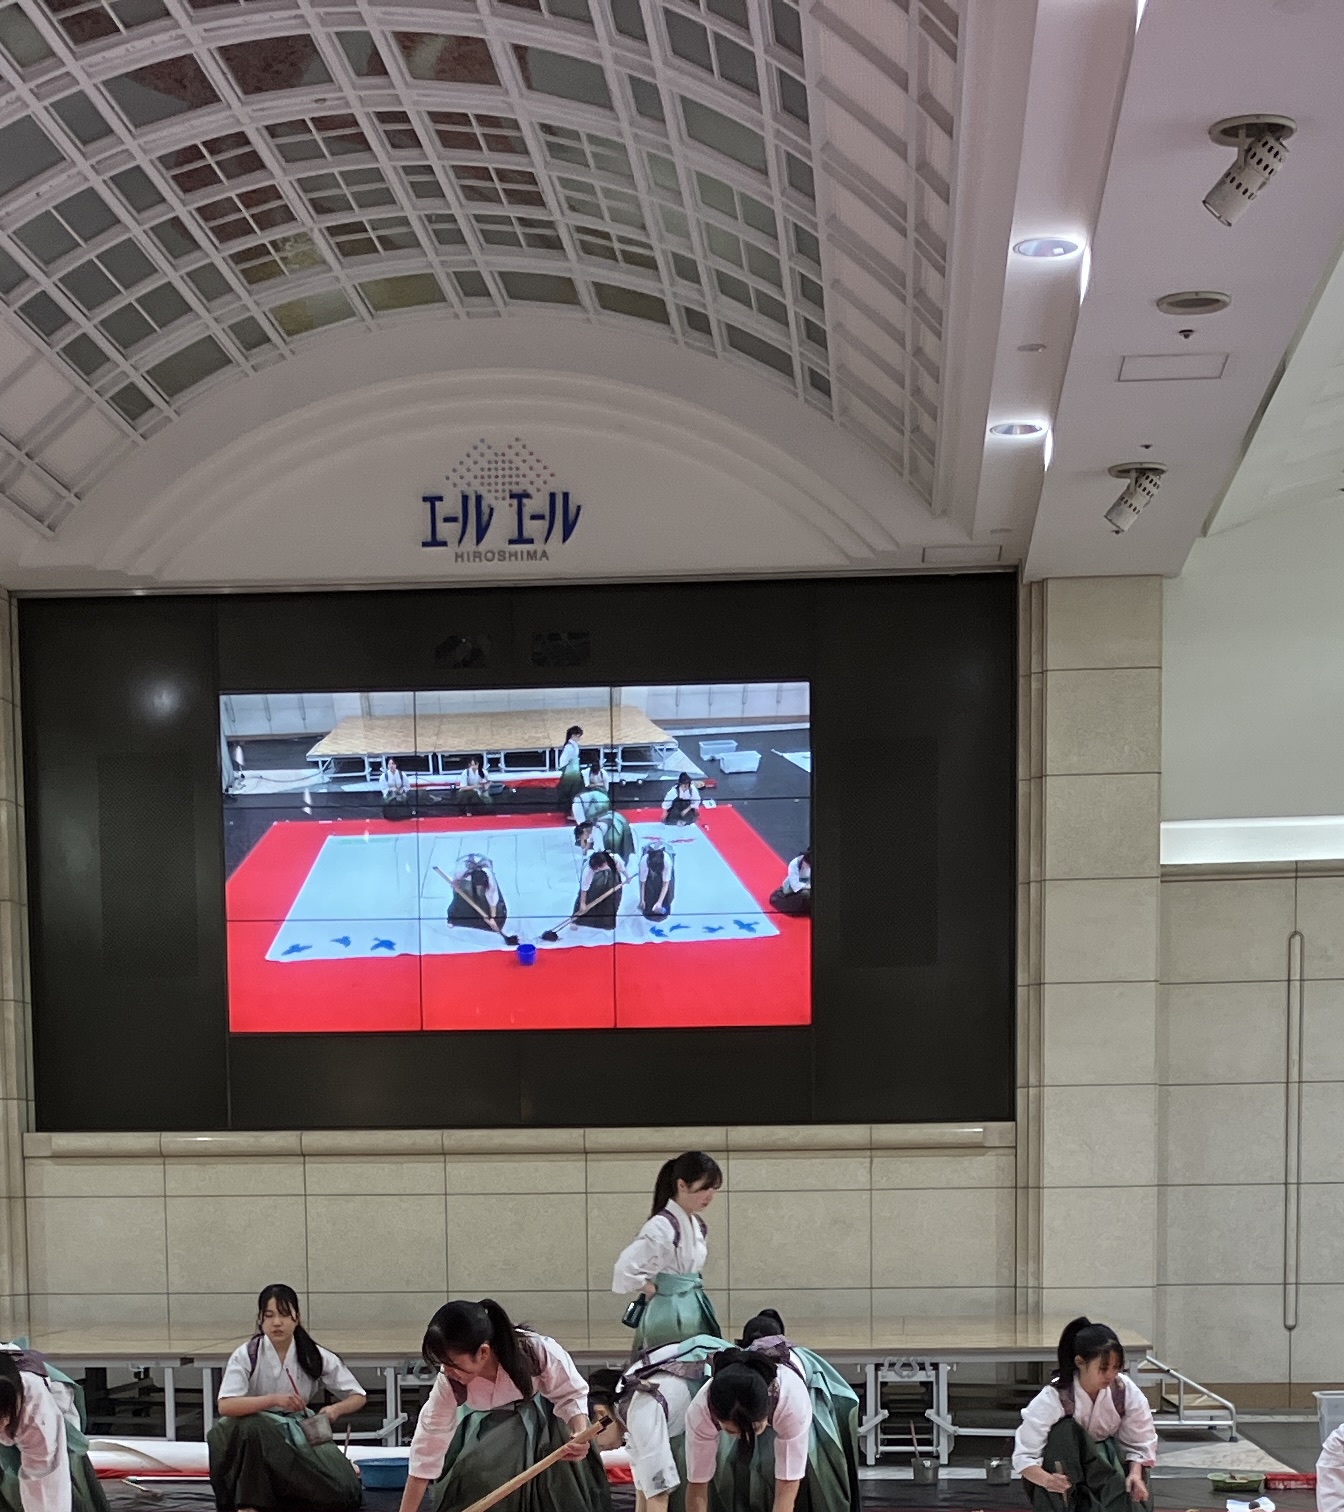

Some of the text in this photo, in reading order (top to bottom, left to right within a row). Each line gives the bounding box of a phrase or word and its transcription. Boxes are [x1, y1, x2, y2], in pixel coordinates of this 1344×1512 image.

[421, 491, 582, 548] エール エール
[455, 550, 549, 563] HIROSHIMA
